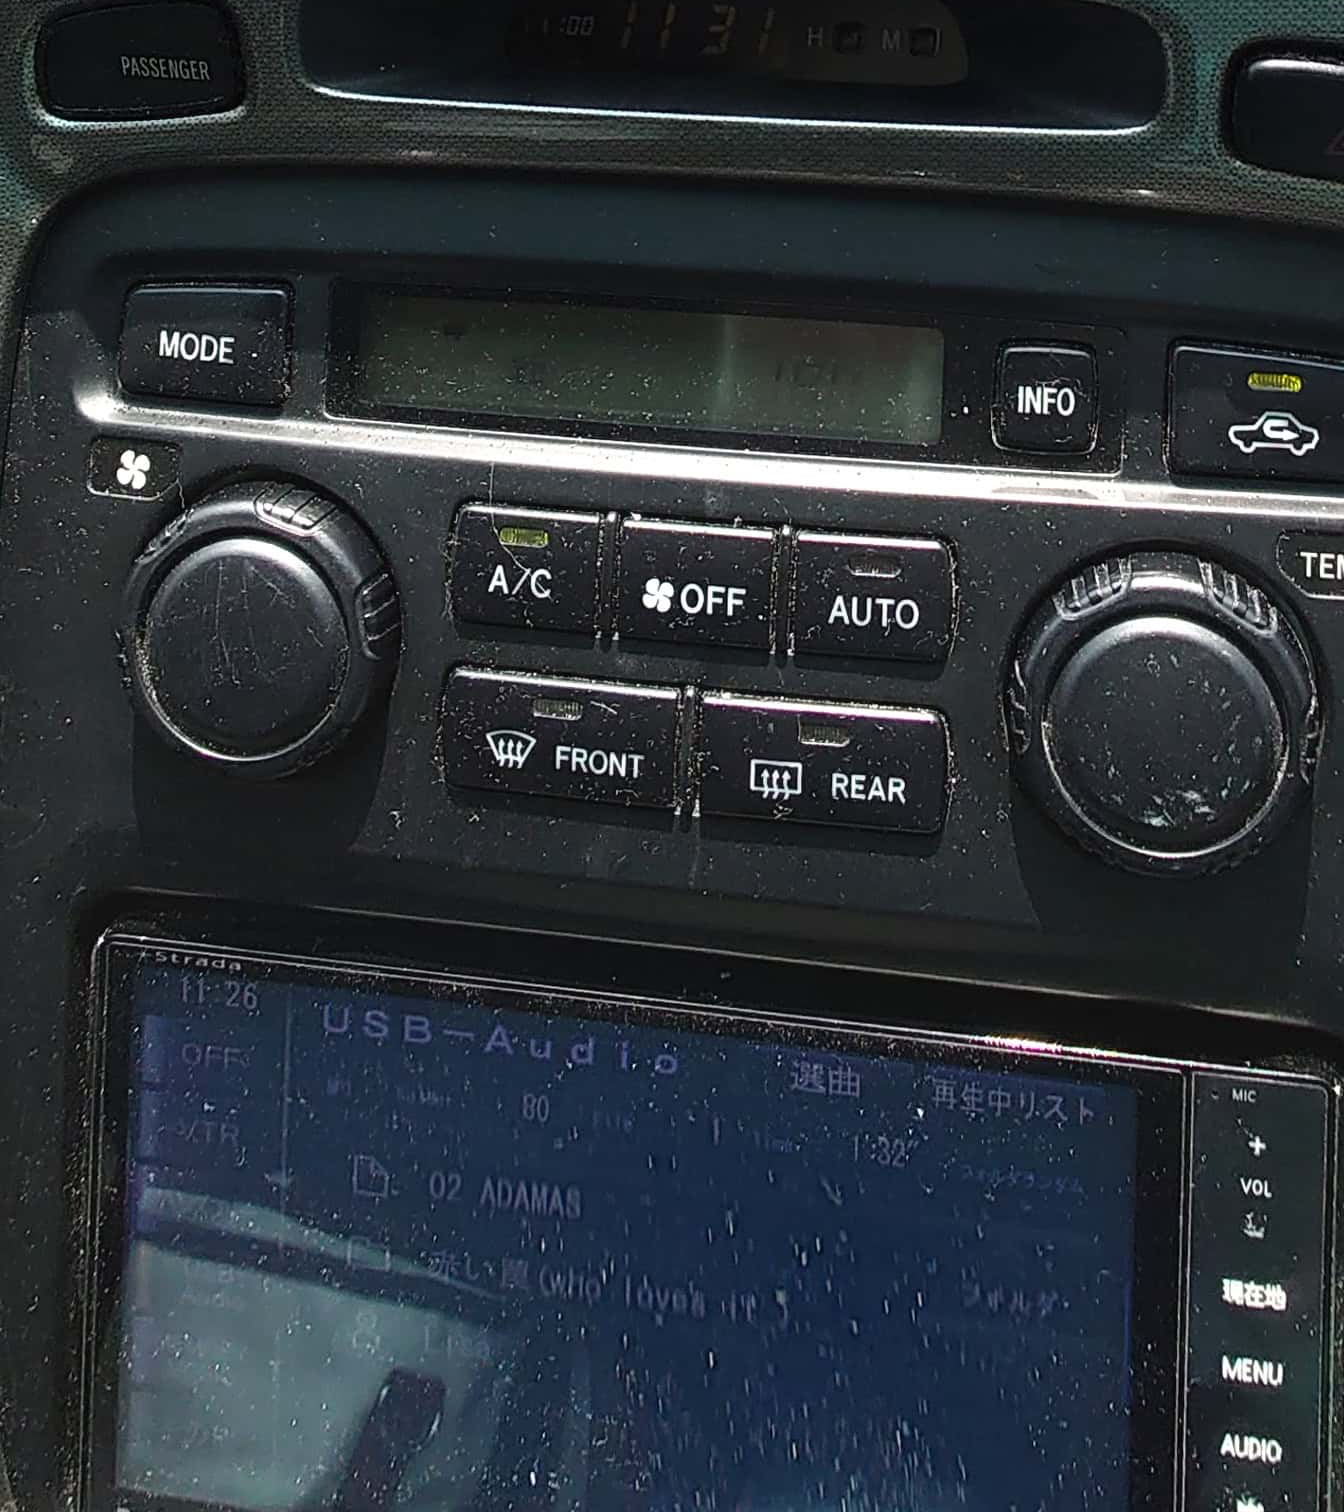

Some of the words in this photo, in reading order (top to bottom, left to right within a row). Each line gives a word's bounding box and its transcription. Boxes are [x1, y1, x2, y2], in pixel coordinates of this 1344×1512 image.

[121, 55, 210, 81] PASSENGER
[158, 330, 236, 364] MODE
[1016, 386, 1076, 417] INFO
[488, 565, 553, 598] A/C
[680, 587, 747, 617] OFF
[827, 595, 921, 630] AUTO
[555, 744, 645, 779] FRONT
[831, 773, 907, 805] REAR
[155, 951, 242, 971] Strada
[790, 1060, 861, 1098] 選曲
[930, 1078, 1094, 1125] 再生中リスト
[1232, 1087, 1257, 1103] MIC
[1240, 1177, 1273, 1198] VOL
[1221, 1355, 1284, 1386] MENU
[1220, 1433, 1283, 1463] AUDIO
